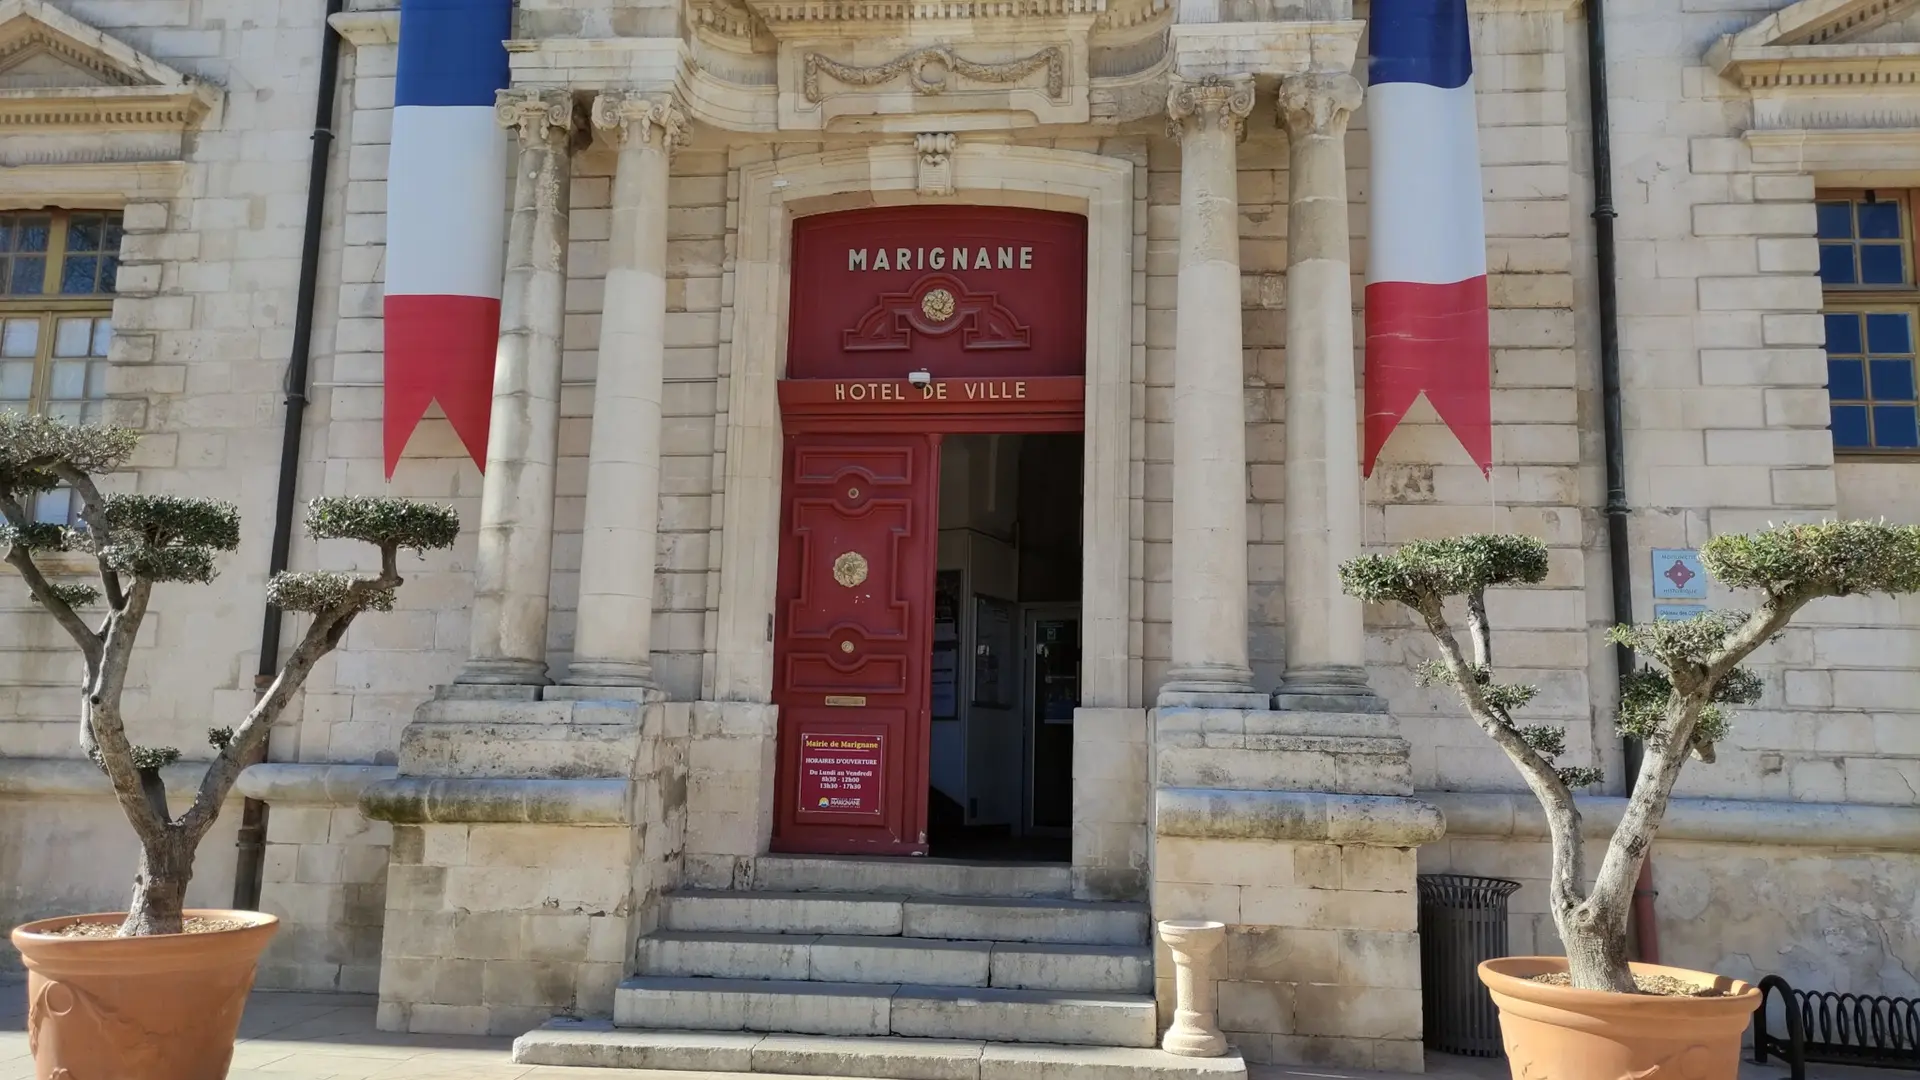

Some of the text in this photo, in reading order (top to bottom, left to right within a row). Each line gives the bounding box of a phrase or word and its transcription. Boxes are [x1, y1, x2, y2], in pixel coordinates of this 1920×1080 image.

[848, 246, 1033, 271] MARIGNANE
[834, 381, 1026, 401] HOTEL DE VILLE
[806, 740, 829, 748] Mairie
[841, 741, 878, 749] Marignane
